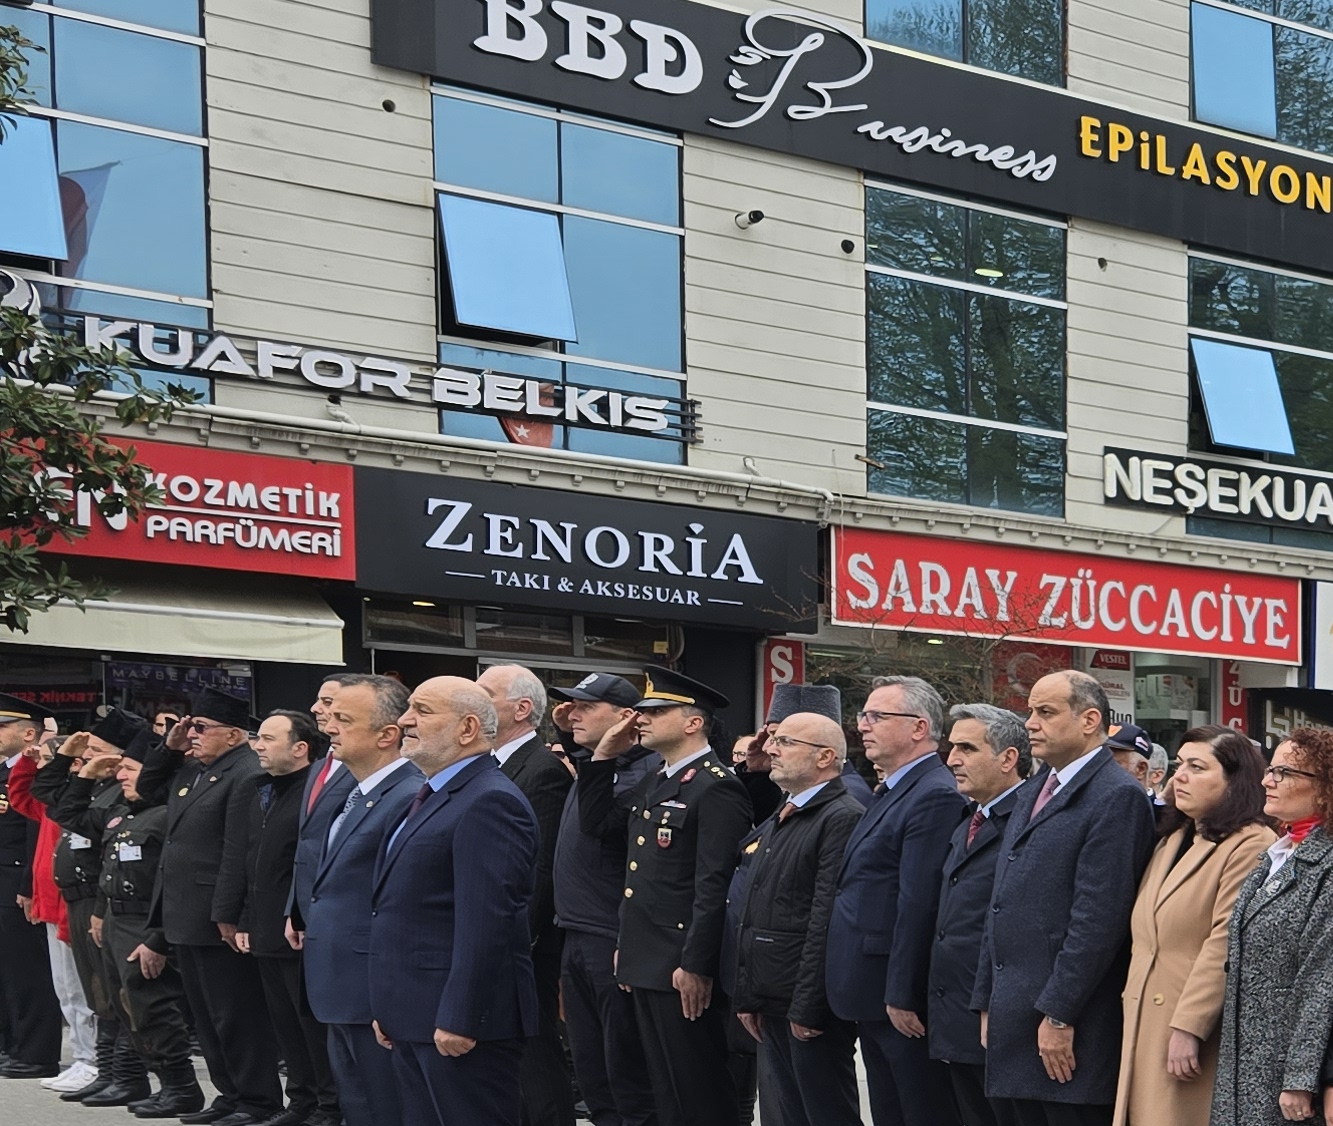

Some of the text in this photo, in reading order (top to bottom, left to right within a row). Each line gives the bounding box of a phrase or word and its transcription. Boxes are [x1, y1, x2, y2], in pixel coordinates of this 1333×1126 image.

[474, 0, 702, 94] BBD
[433, 366, 670, 432] BELKIS
[147, 515, 341, 557] PARFÜMERİ
[425, 498, 764, 584] ZENORİA
[491, 569, 702, 606] TAKI & AKSESUAR
[847, 552, 1290, 648] SARAY ZÜCCACİYE
[112, 668, 247, 687] MAYBELLINE
[1100, 653, 1128, 665] VESTEL
